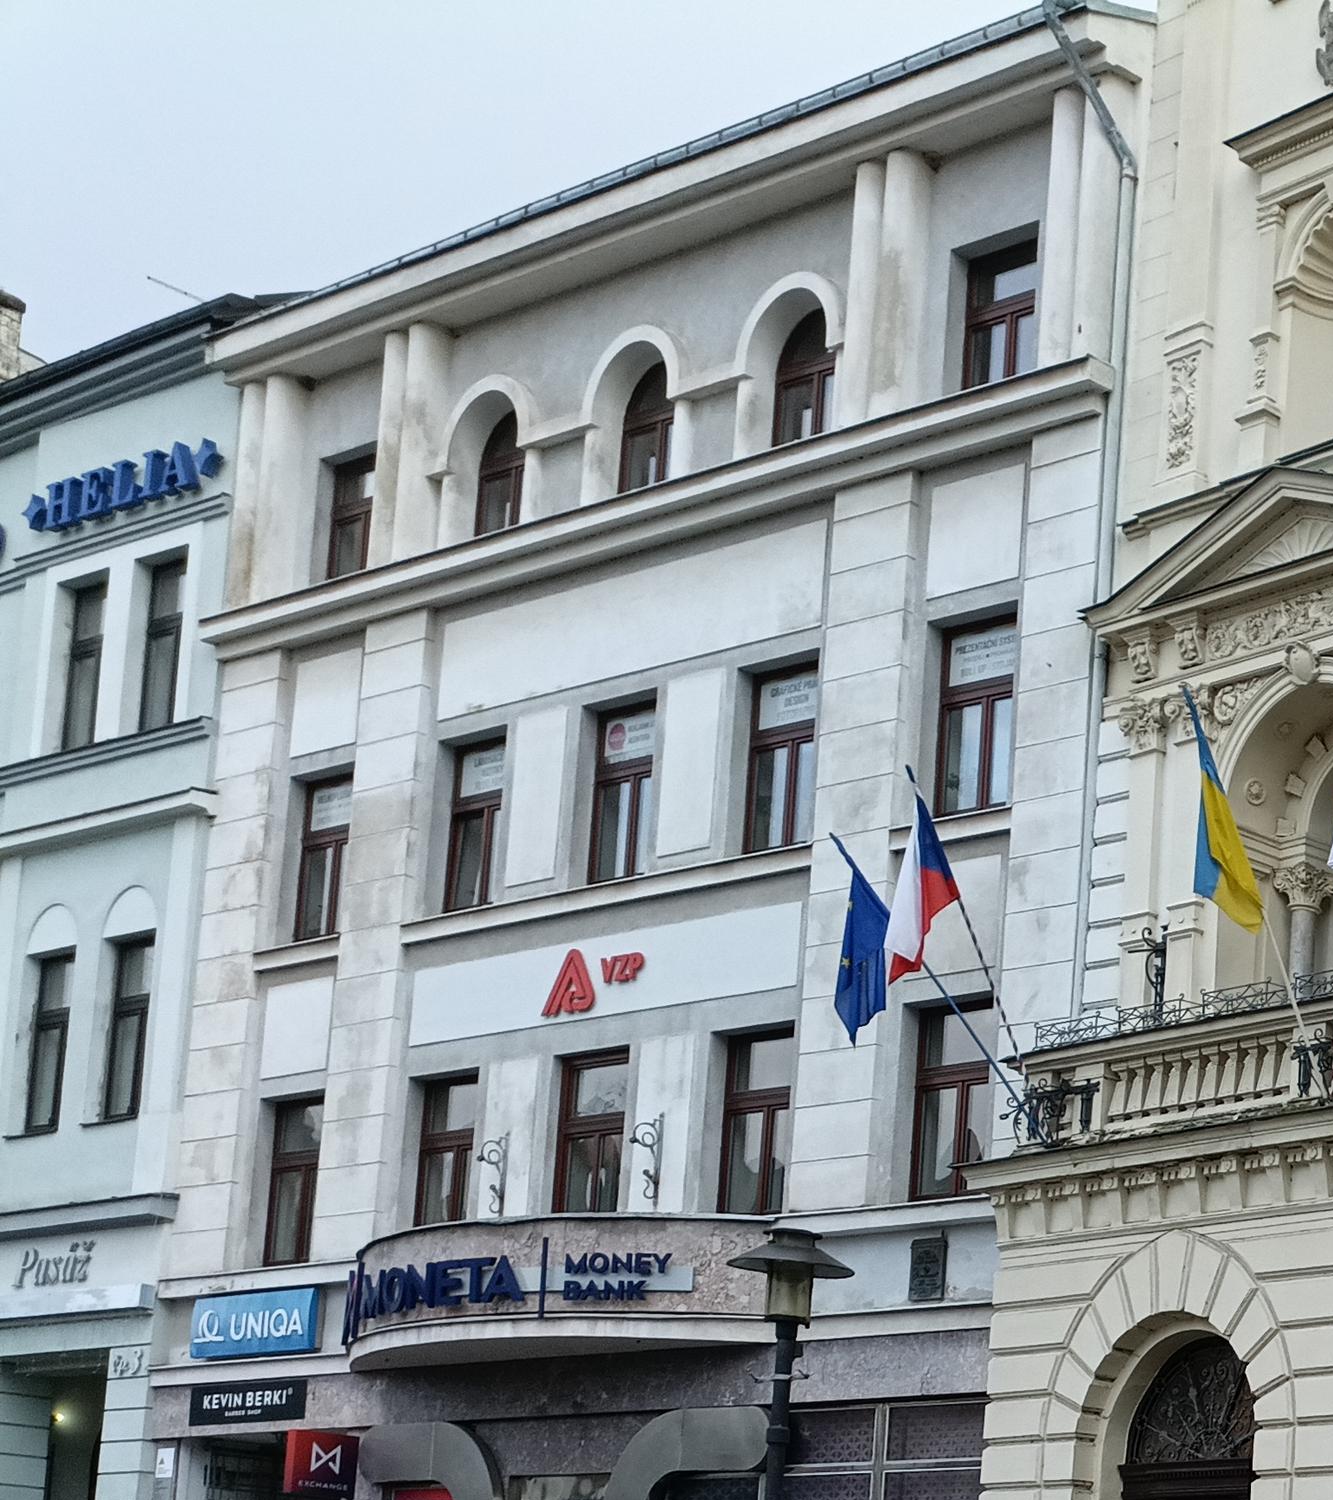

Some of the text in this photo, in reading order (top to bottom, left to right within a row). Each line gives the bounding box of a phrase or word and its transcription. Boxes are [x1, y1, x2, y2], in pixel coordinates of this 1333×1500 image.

[45, 441, 200, 532] HELIA
[600, 952, 646, 985] VZP
[11, 1240, 97, 1289] Pasáž
[360, 1251, 673, 1320] MONETA MONEY
[563, 1279, 650, 1301] BANK
[229, 1308, 303, 1341] UNIQA
[202, 1392, 243, 1410] KEVIN
[297, 1479, 348, 1491] EXCHANGE
